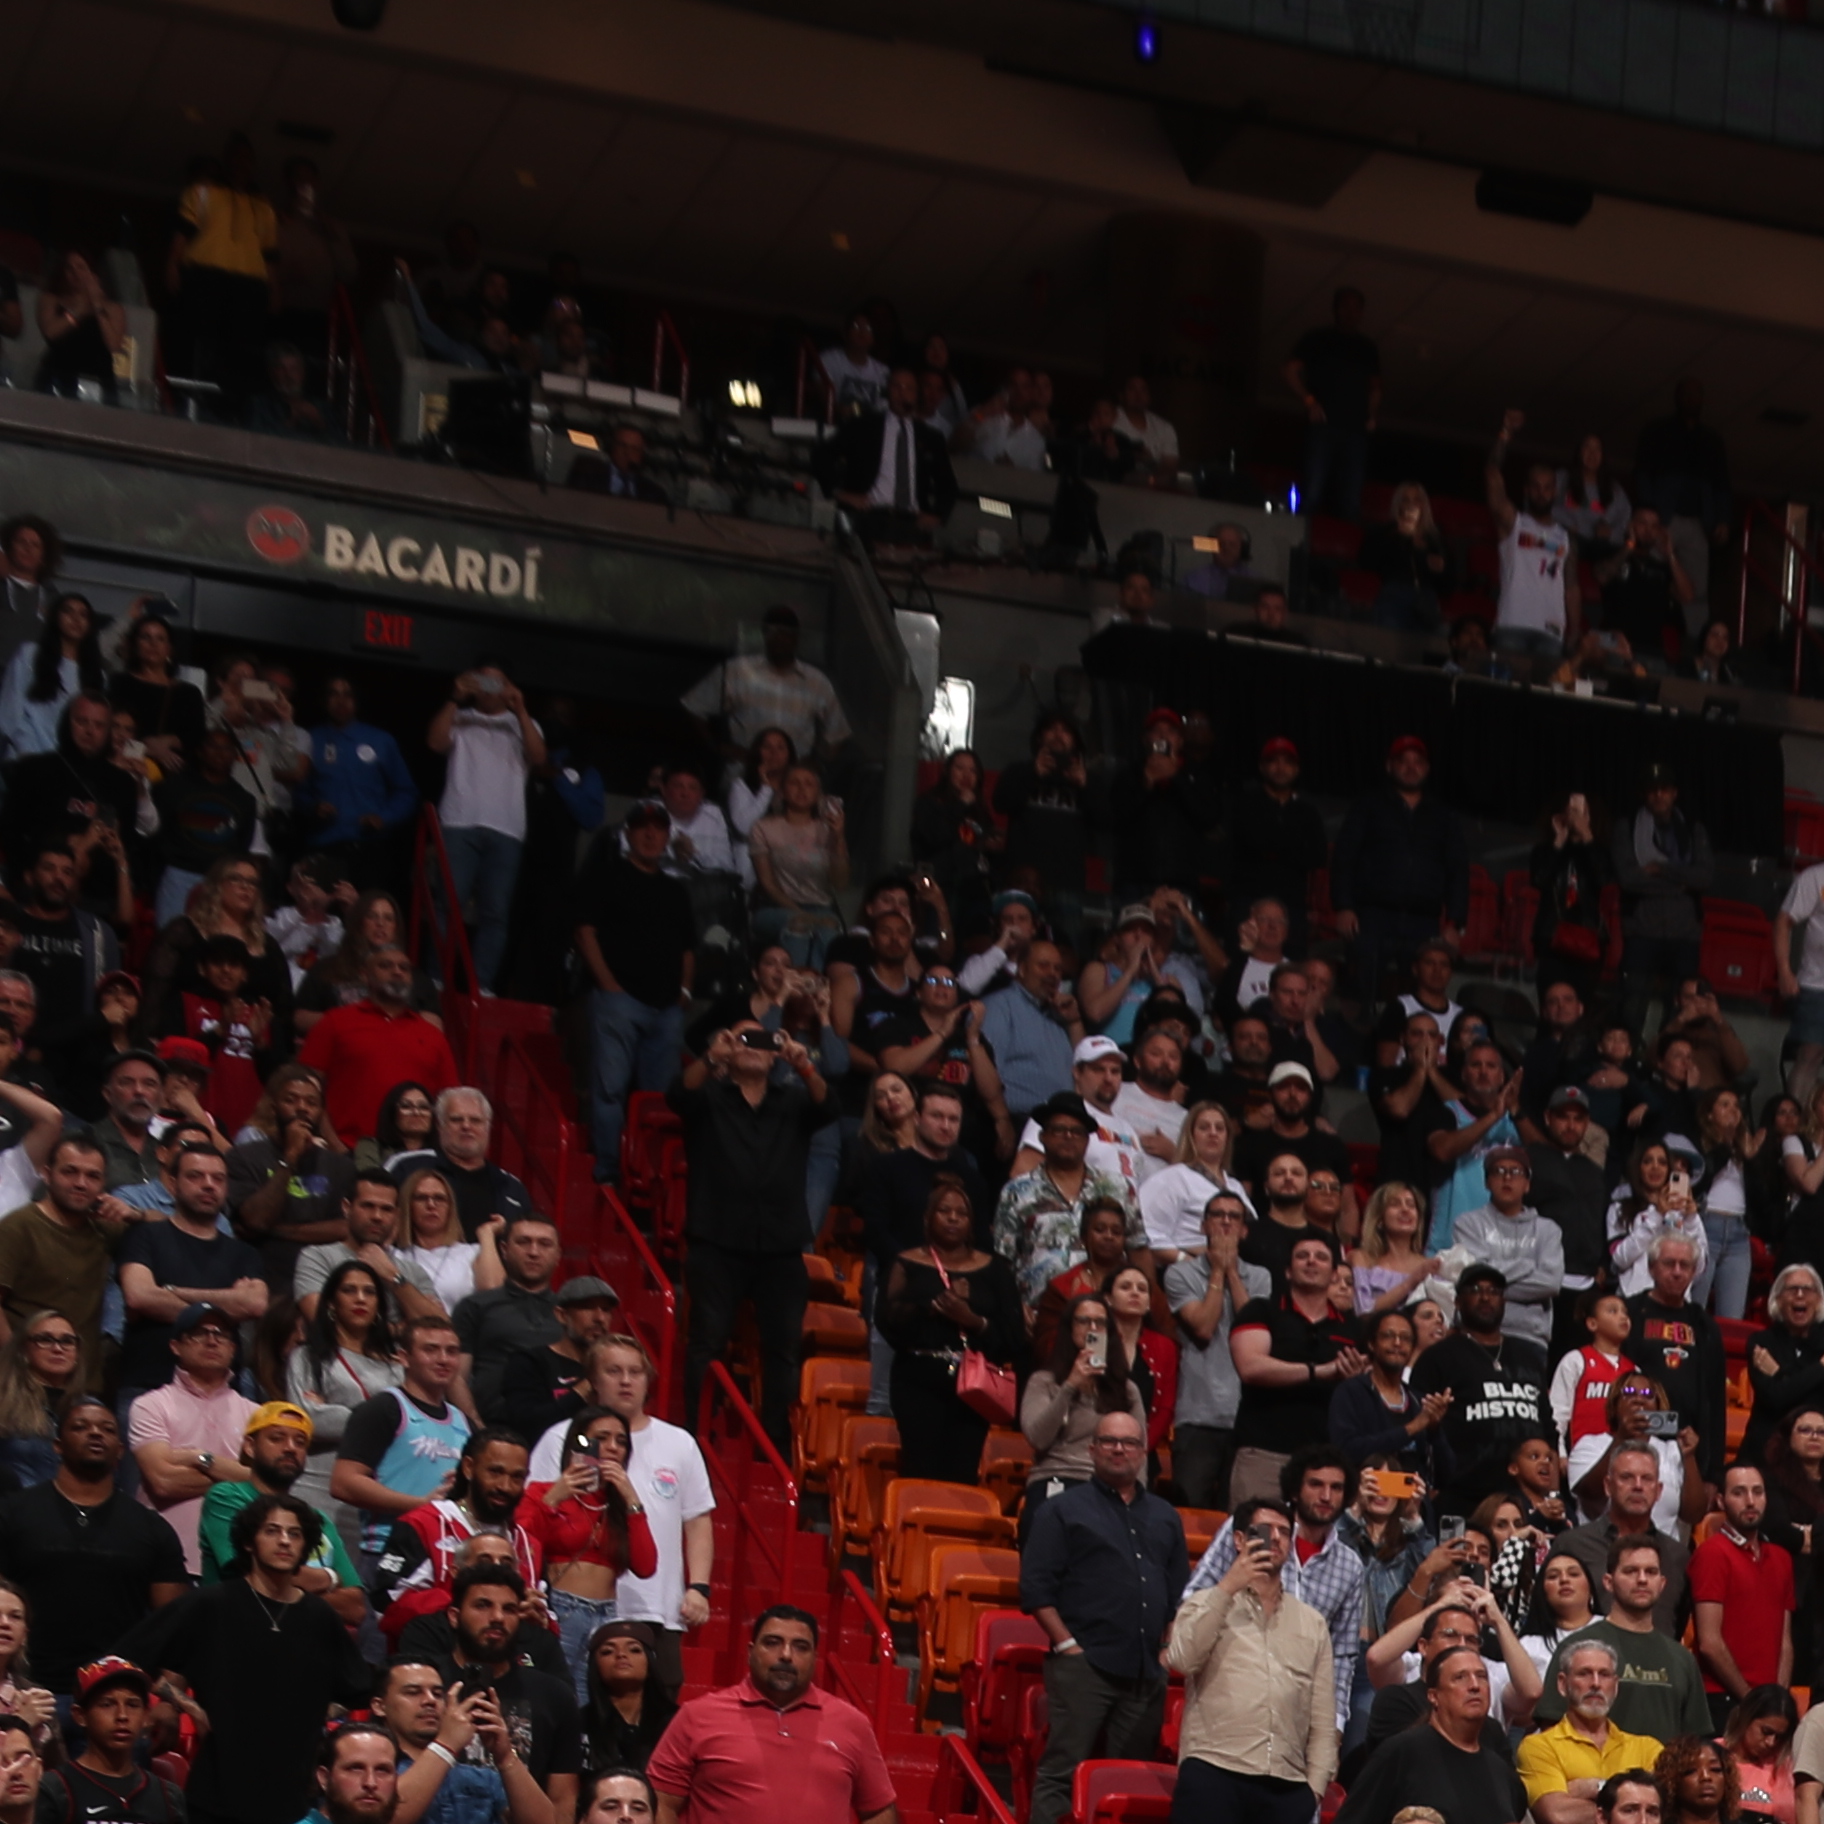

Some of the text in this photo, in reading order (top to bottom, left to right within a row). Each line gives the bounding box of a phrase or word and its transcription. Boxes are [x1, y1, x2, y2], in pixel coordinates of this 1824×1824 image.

[323, 523, 545, 602] BACARDÍ
[364, 611, 415, 649] EXIT
[21, 933, 85, 958] ULTURE
[1483, 1381, 1541, 1402] BLAC
[1466, 1400, 1541, 1423] HISTOR
